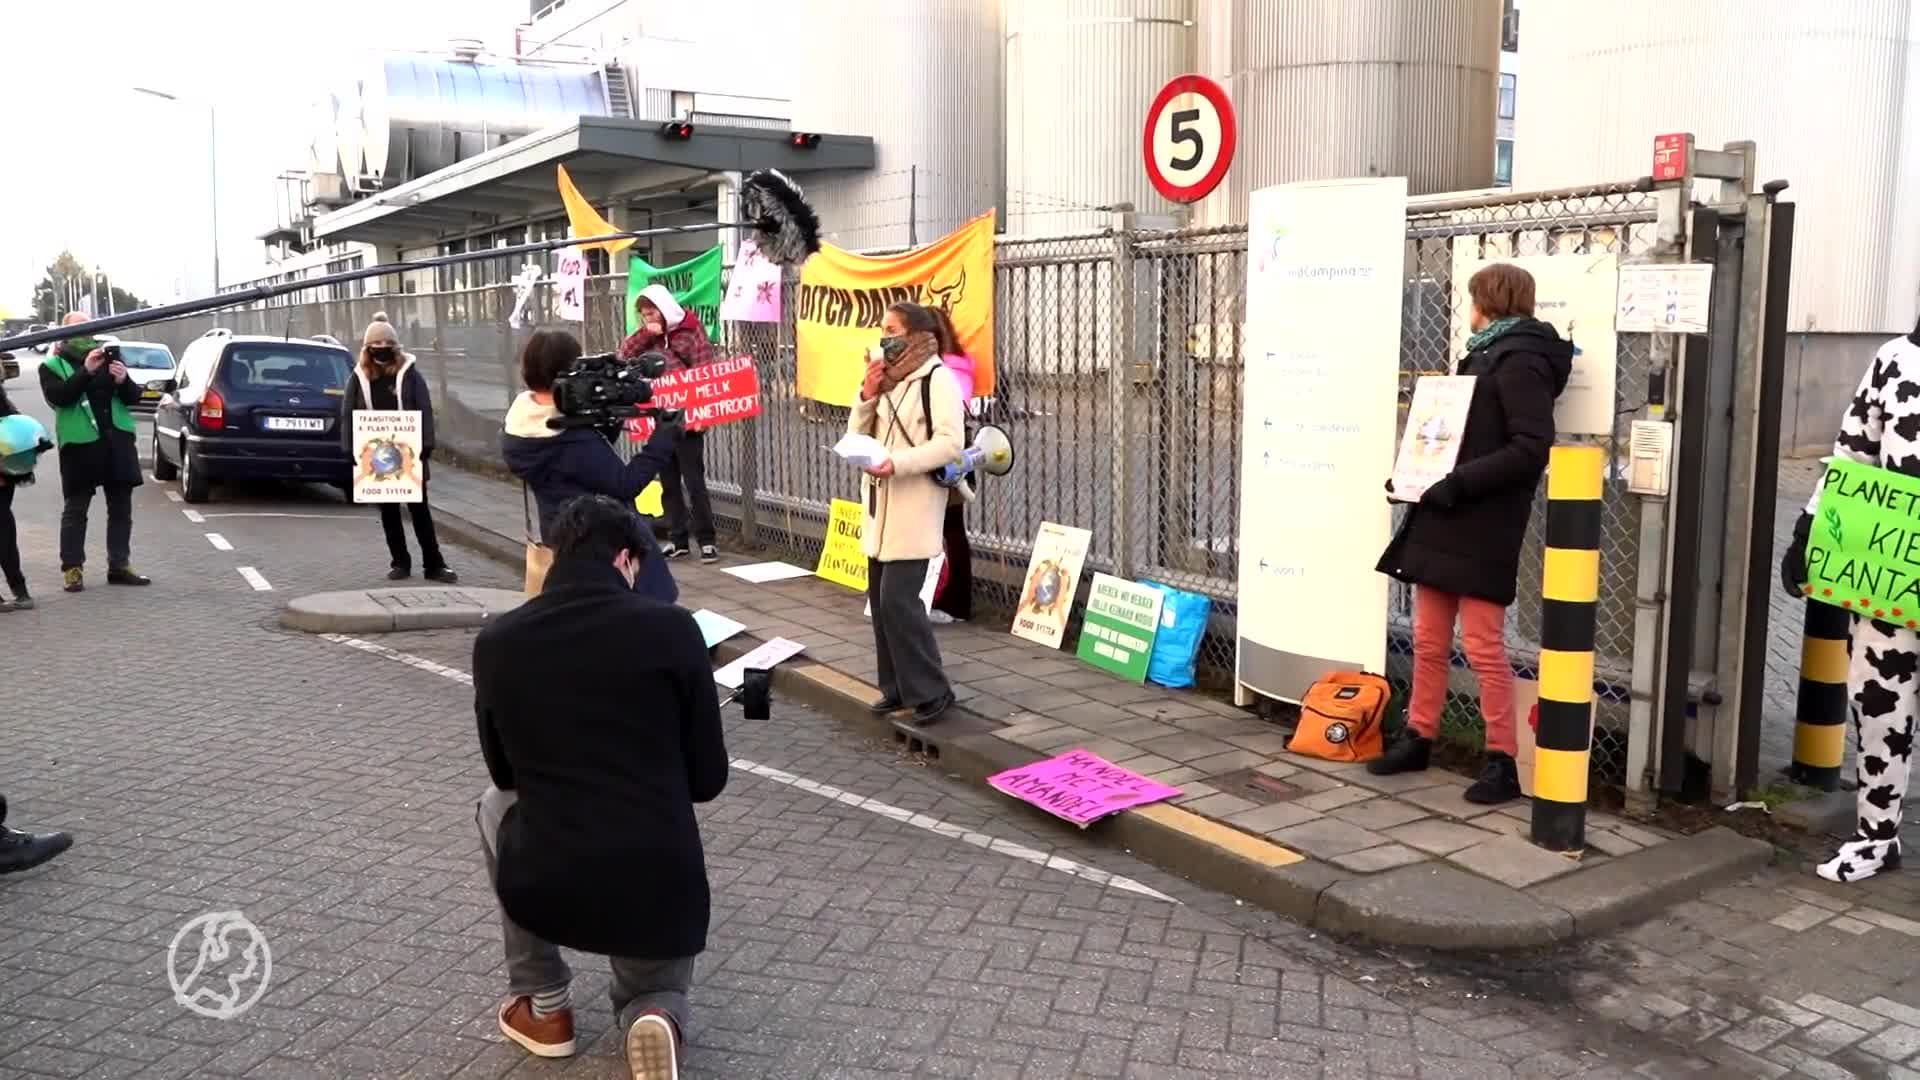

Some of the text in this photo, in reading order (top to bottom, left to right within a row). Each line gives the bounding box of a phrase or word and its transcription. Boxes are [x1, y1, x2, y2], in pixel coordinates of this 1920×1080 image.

[1170, 109, 1203, 171] 5
[800, 284, 853, 327] DITCH
[695, 380, 731, 399] MELK
[359, 415, 415, 423] TRANSITION TO
[361, 487, 412, 495] FOOD SYSTEM
[1823, 468, 1920, 522] PLANET
[1019, 618, 1056, 637] FOOD SYSTEM
[1054, 771, 1113, 793] MET
[1063, 753, 1153, 792] HANDEL
[1001, 773, 1104, 818] AMANDEL
